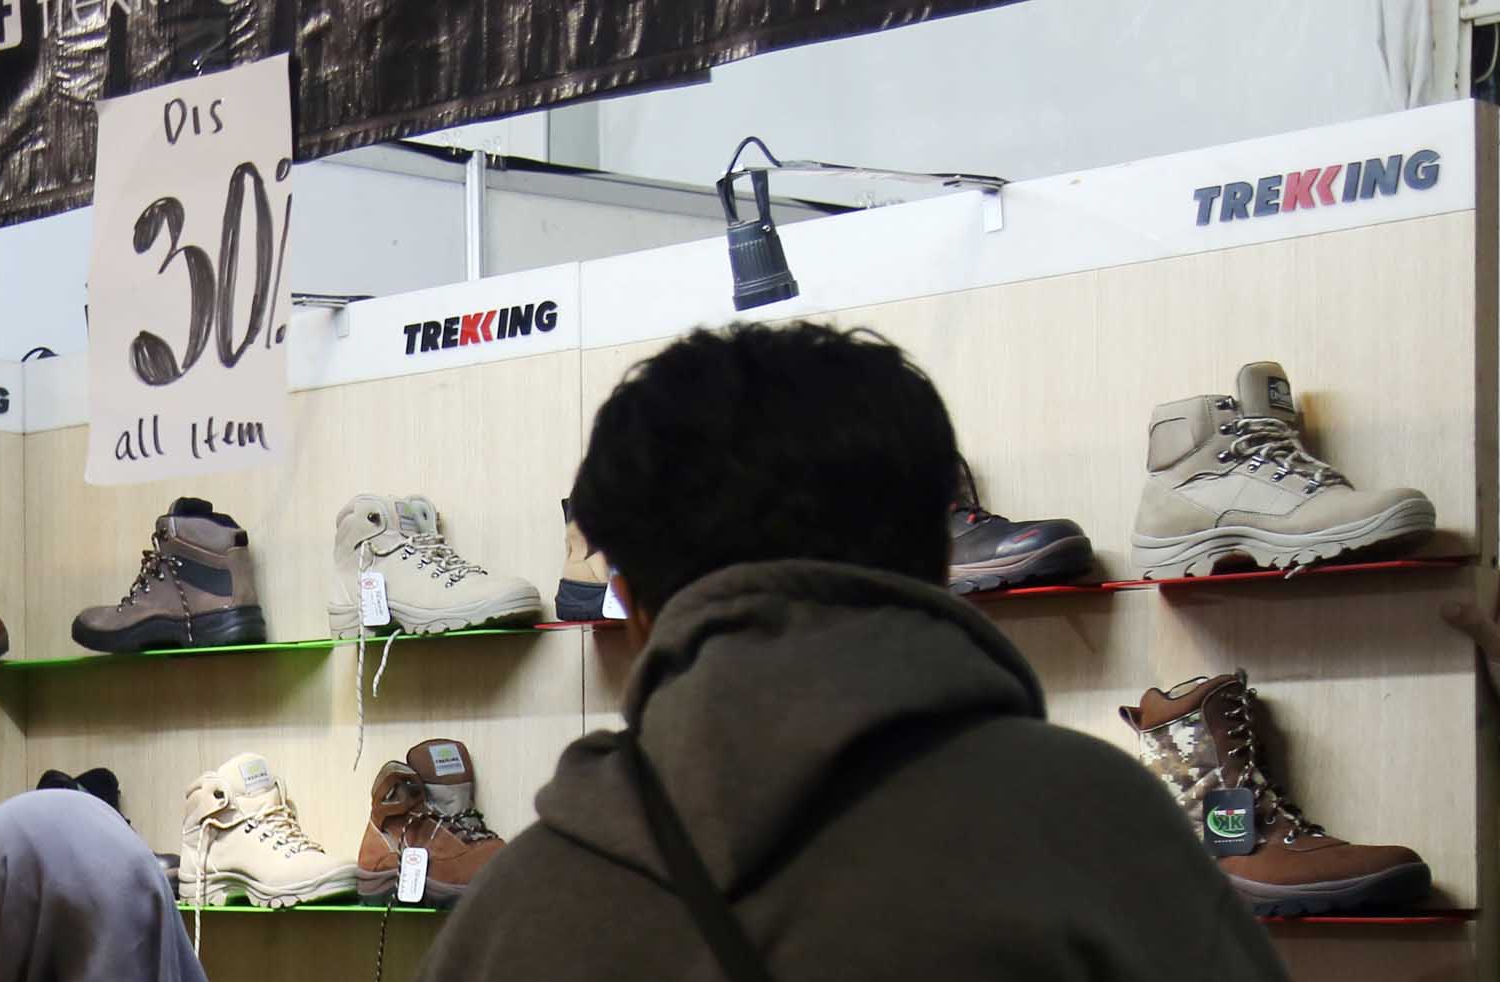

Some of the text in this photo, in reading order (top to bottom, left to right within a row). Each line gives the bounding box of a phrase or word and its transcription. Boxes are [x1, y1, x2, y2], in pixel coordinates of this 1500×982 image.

[1193, 149, 1441, 227] TREKKING
[403, 300, 558, 355] TREKKING
[116, 415, 165, 461] all
